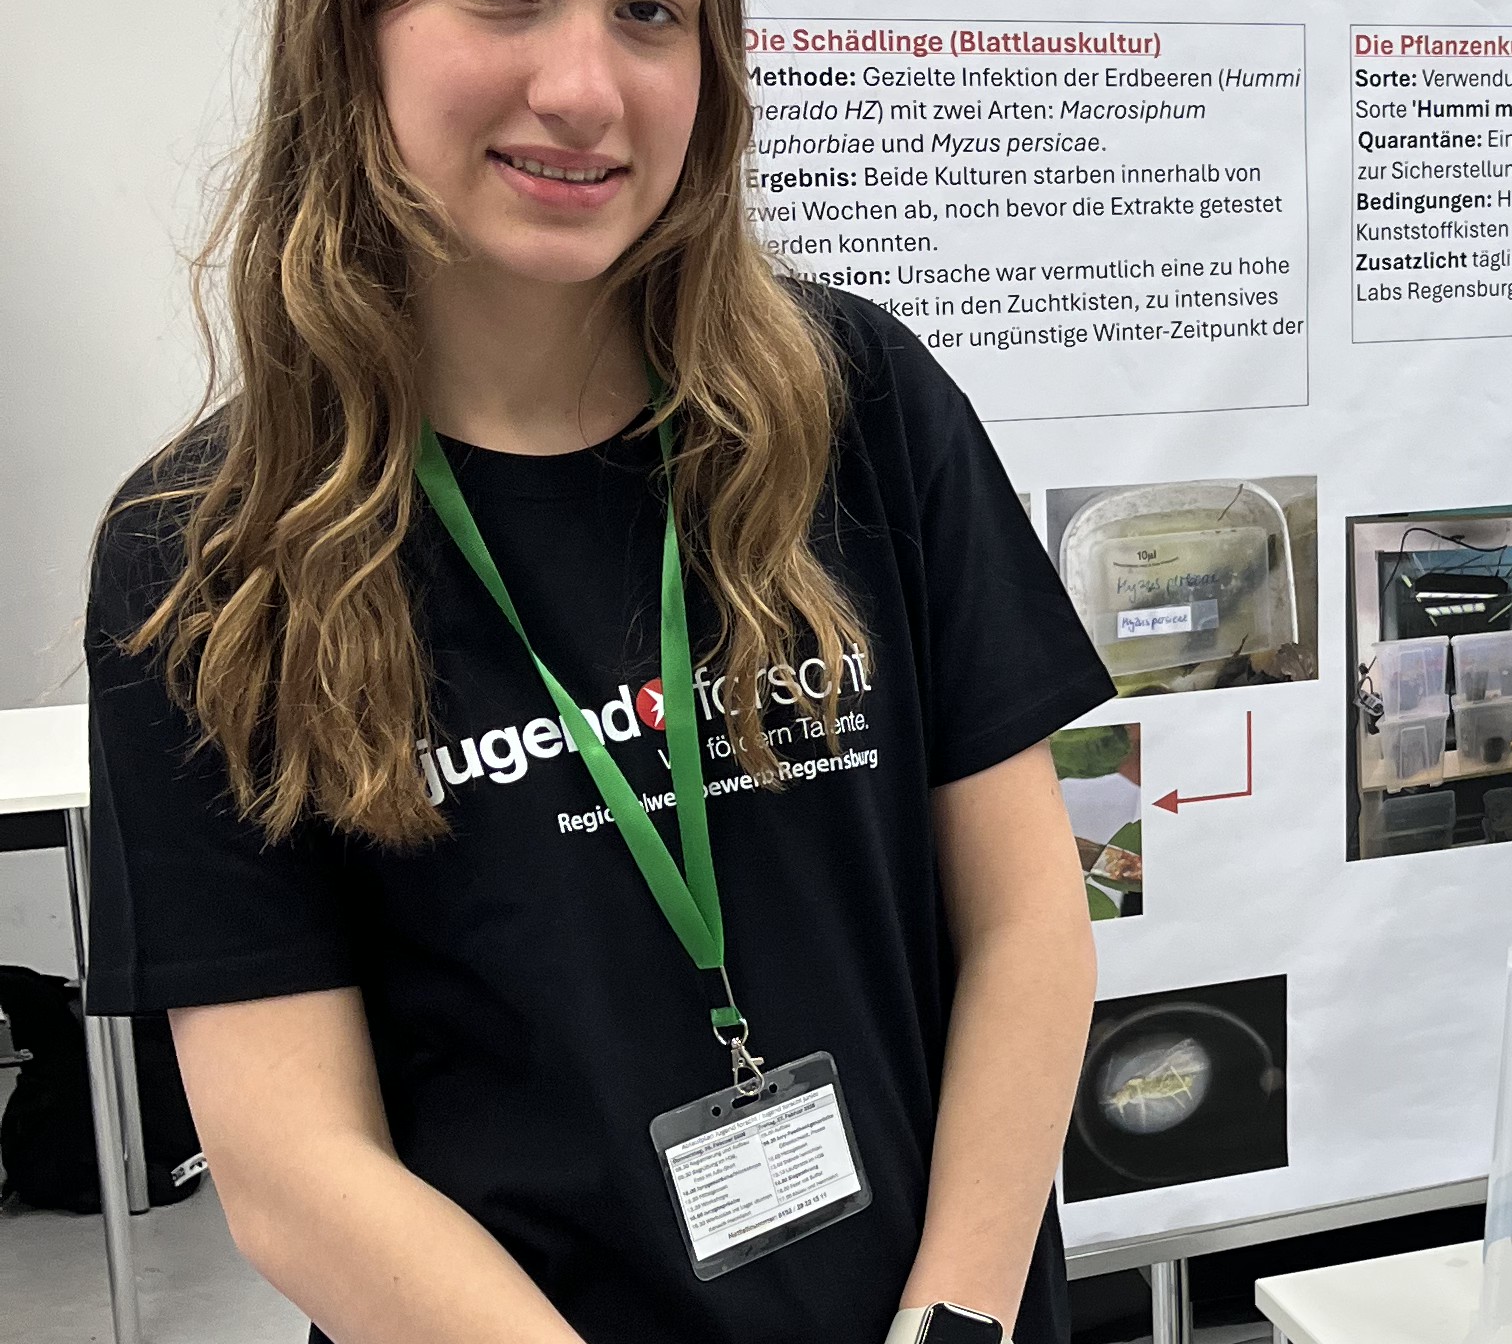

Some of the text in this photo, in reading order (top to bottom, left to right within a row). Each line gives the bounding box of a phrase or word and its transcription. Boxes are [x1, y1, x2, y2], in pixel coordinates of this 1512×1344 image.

[792, 28, 944, 51] Schädlinge
[949, 29, 1161, 53] (Blattlauskultur)
[1355, 34, 1394, 54] Die
[1355, 99, 1407, 119] Sorte
[746, 163, 1261, 195] Ergebnis: Beide Kulturen starben innerhalb von
[1356, 191, 1493, 215] Bedingungen:
[778, 747, 879, 782] Regensburg
